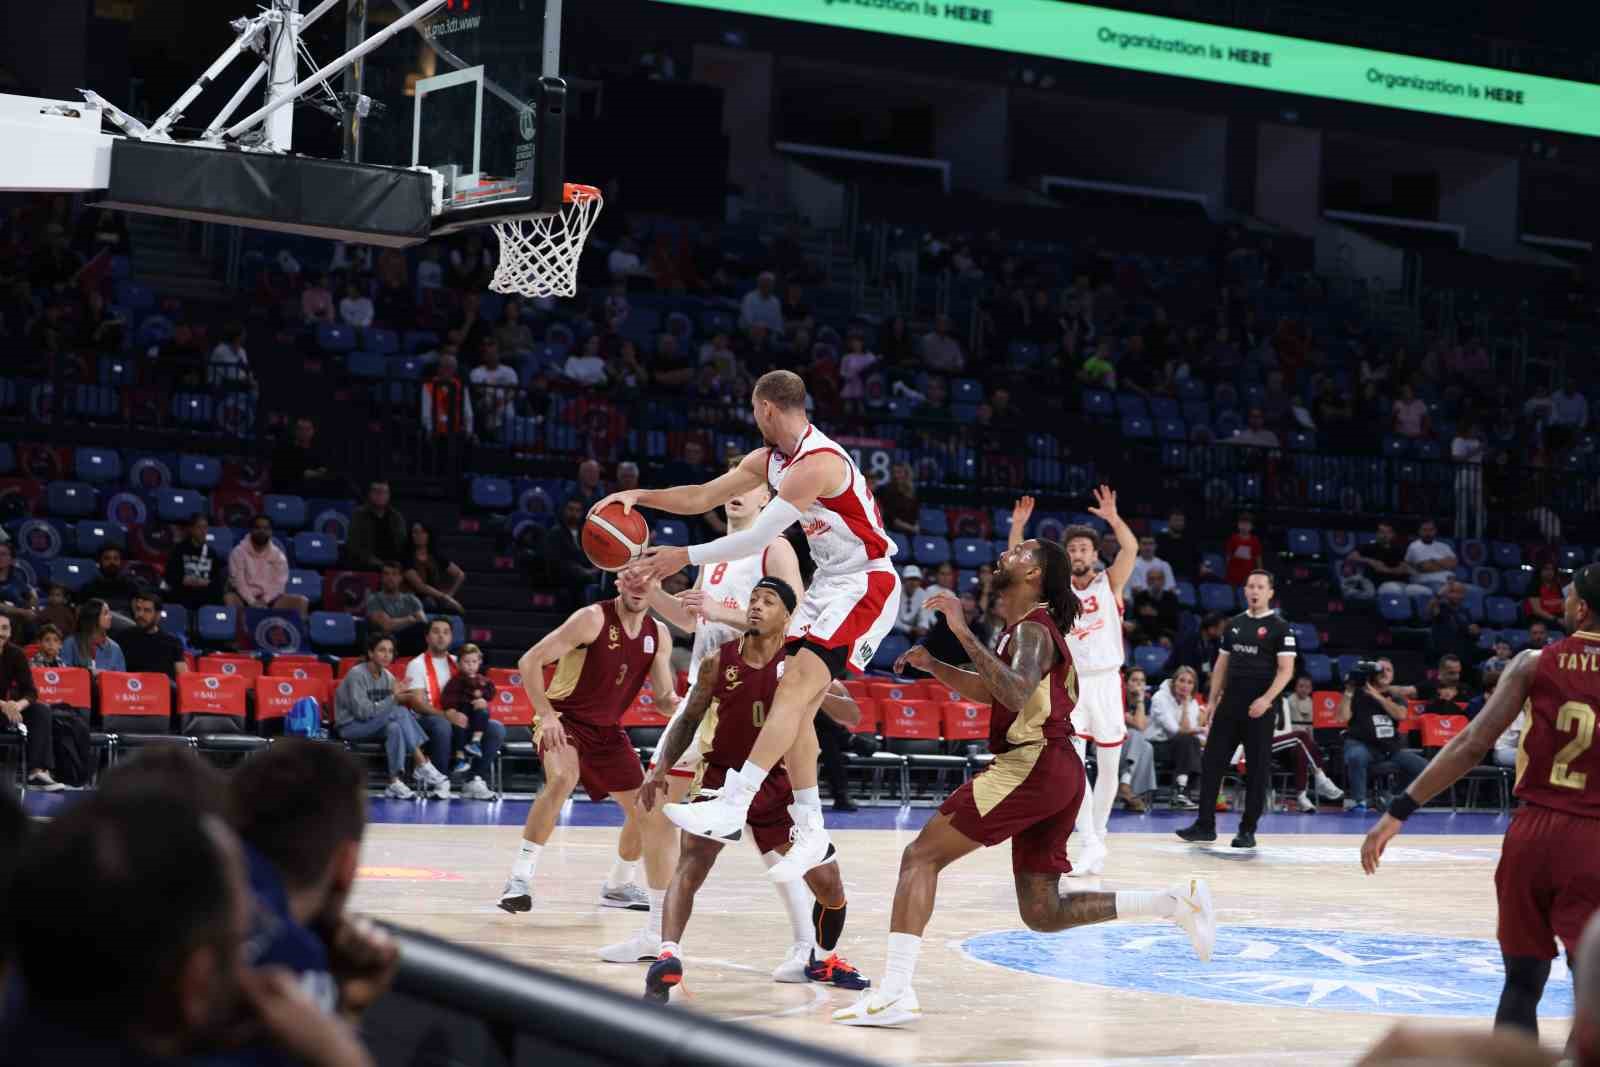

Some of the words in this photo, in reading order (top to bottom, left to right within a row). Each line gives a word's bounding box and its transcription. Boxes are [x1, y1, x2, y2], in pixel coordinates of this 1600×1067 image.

[944, 5, 992, 24] HERE
[1097, 27, 1206, 57] Organization
[1228, 48, 1272, 67] HERE
[1366, 67, 1465, 96] Organization
[1484, 86, 1524, 105] HERE
[850, 449, 890, 486] 18
[710, 561, 728, 585] 8
[615, 663, 629, 686] 3
[752, 700, 765, 727] 0
[1549, 701, 1596, 789] 2
